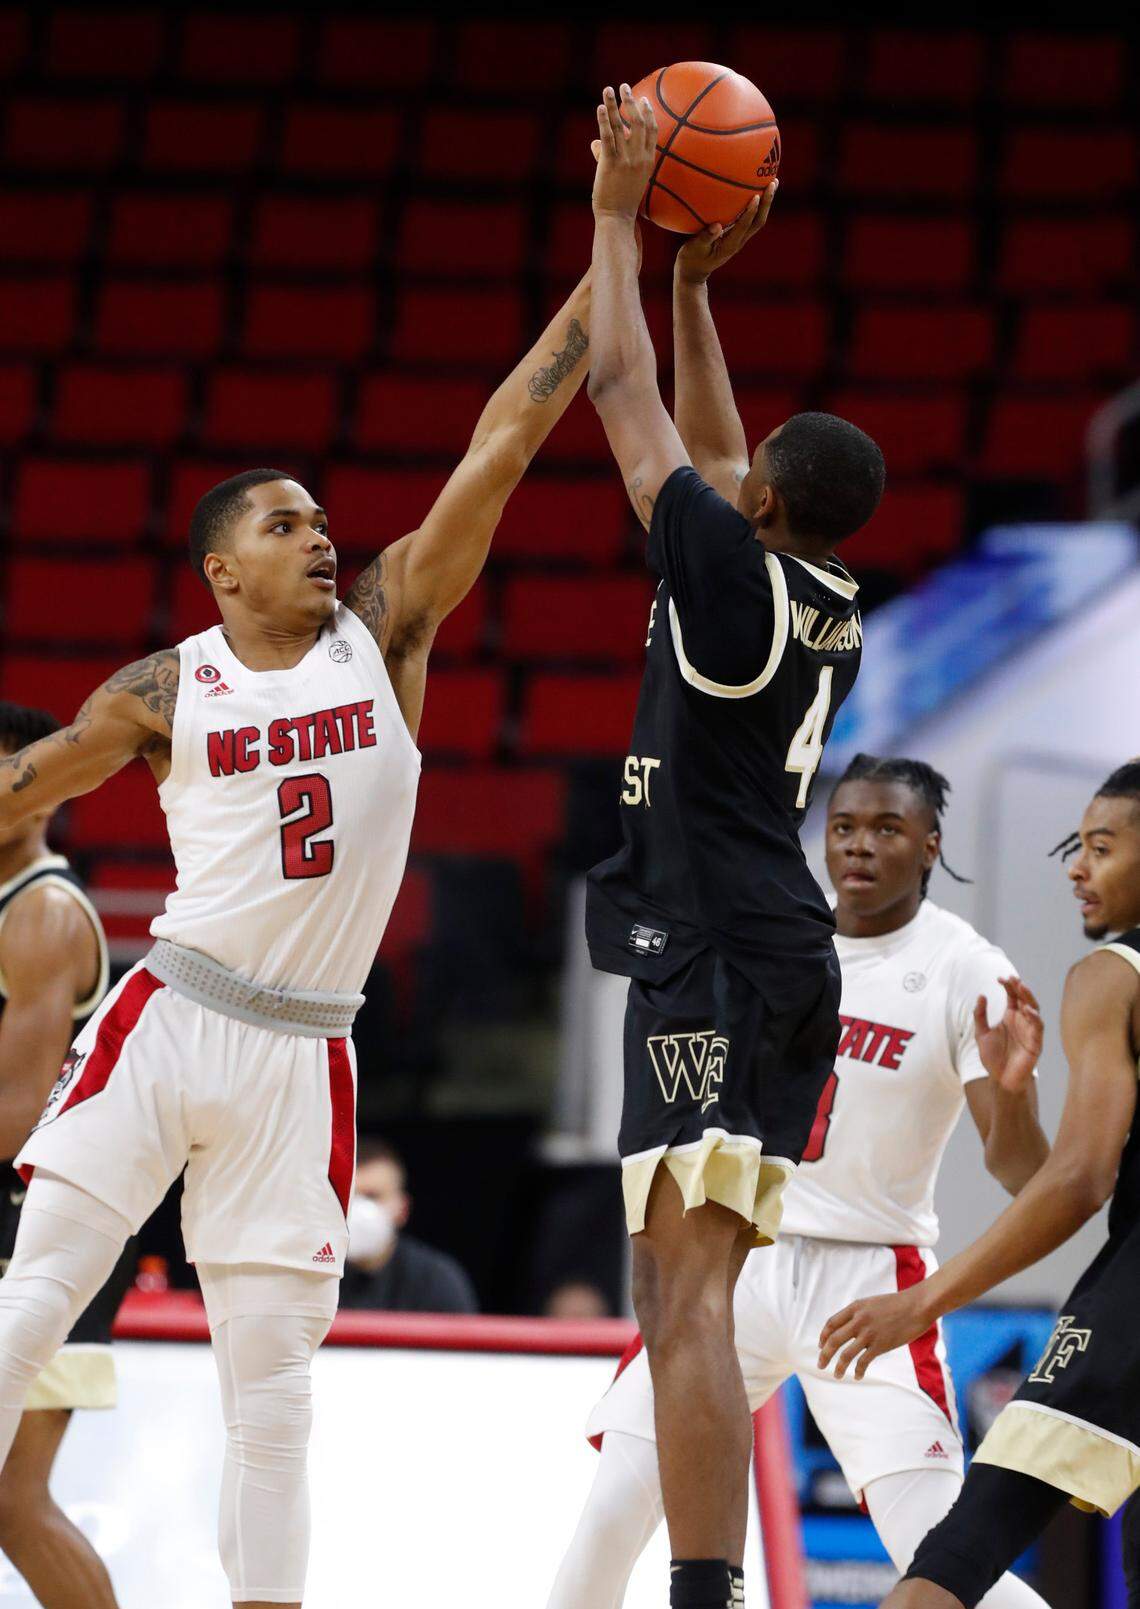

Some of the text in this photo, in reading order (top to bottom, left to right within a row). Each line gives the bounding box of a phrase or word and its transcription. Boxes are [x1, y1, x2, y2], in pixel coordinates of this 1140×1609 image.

[207, 699, 377, 777] NC STATE
[784, 665, 834, 808] 4
[277, 772, 335, 880] 2
[312, 1254, 336, 1263] adida
